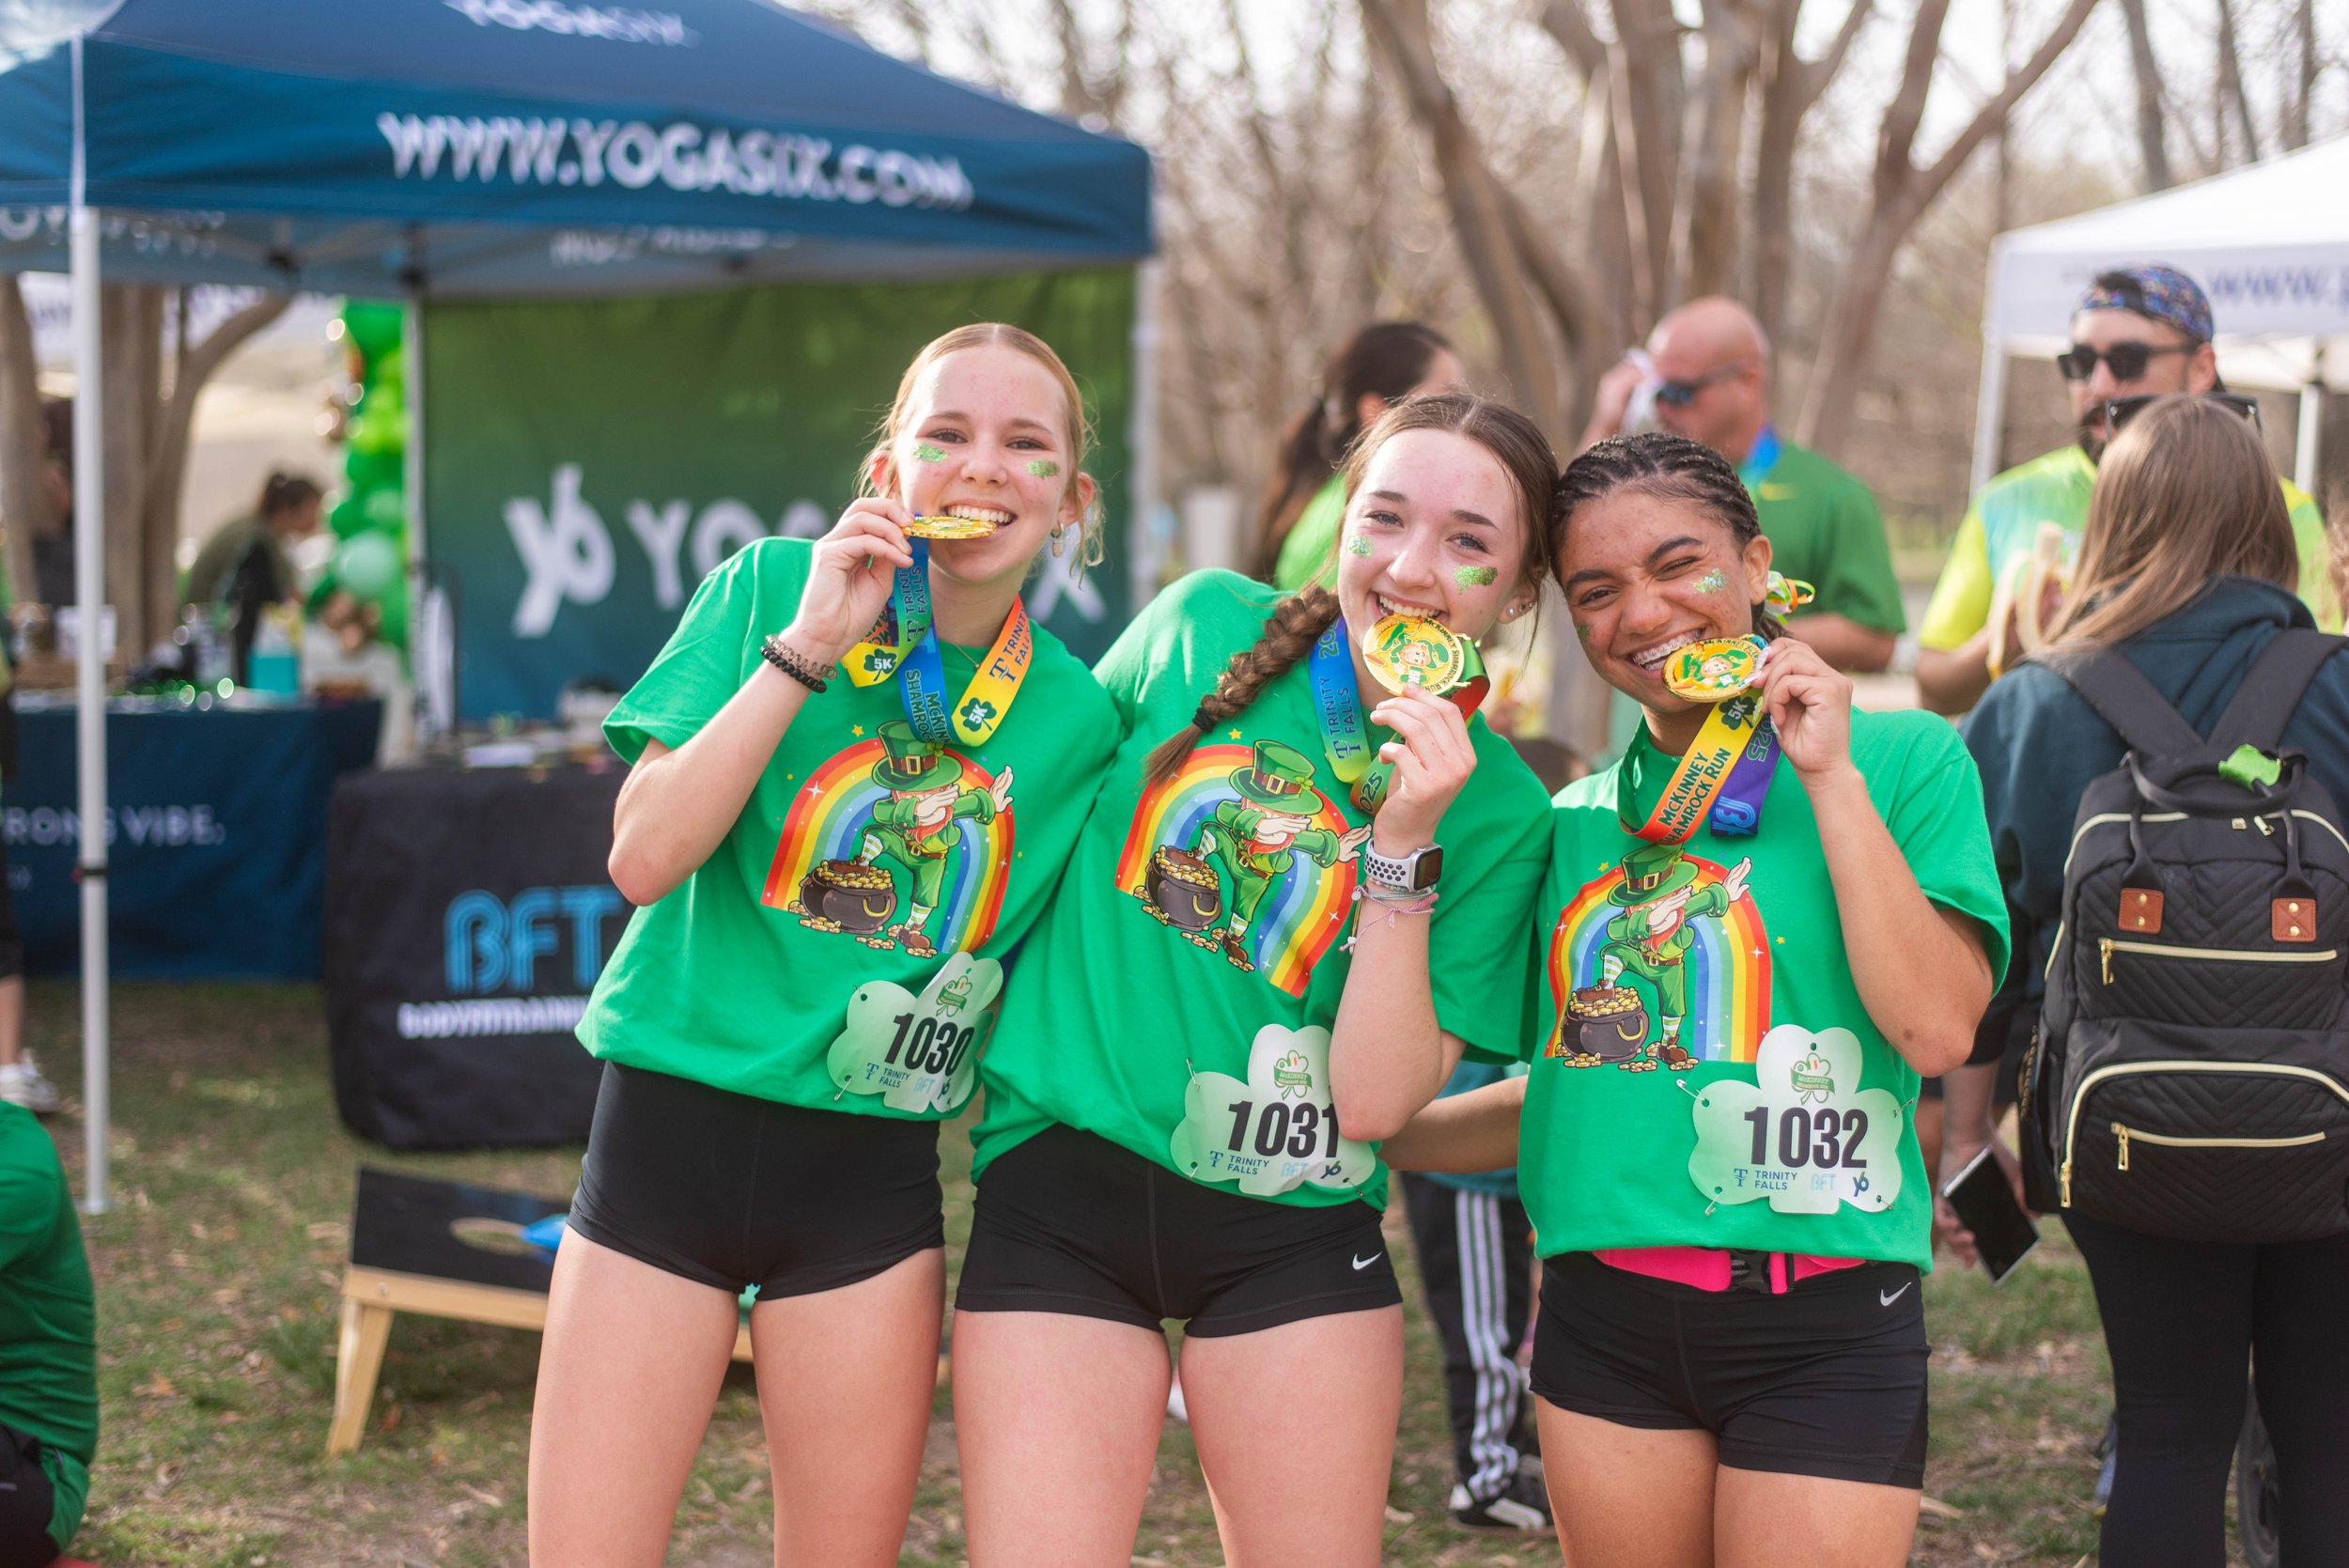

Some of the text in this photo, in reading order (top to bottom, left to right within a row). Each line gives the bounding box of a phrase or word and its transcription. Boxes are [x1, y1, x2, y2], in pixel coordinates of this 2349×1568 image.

[377, 111, 974, 210] WWW.YOGASIX.COM
[898, 566, 915, 614] TRINIT
[911, 566, 927, 614] FALLS
[874, 658, 893, 671] 5K
[905, 669, 935, 743] SHAMROC
[969, 703, 988, 724] 5K
[1320, 676, 1341, 736] TRINITY
[1338, 687, 1356, 735] FALLS
[1728, 702, 1748, 722] 5K
[1359, 771, 1384, 815] 025
[1657, 747, 1734, 845] SHAMROCK RUN
[444, 884, 624, 994] BFT
[883, 1012, 975, 1078] 1030
[879, 1076, 902, 1089] FALLS
[883, 1067, 911, 1080] TRINITY
[1227, 1100, 1340, 1158] 1031
[1744, 1106, 1869, 1169] 1032
[1226, 1163, 1258, 1175] FALLS
[1229, 1155, 1270, 1168] TRINITY
[1754, 1179, 1788, 1190] FALLS
[1755, 1170, 1798, 1181] TRINITY
